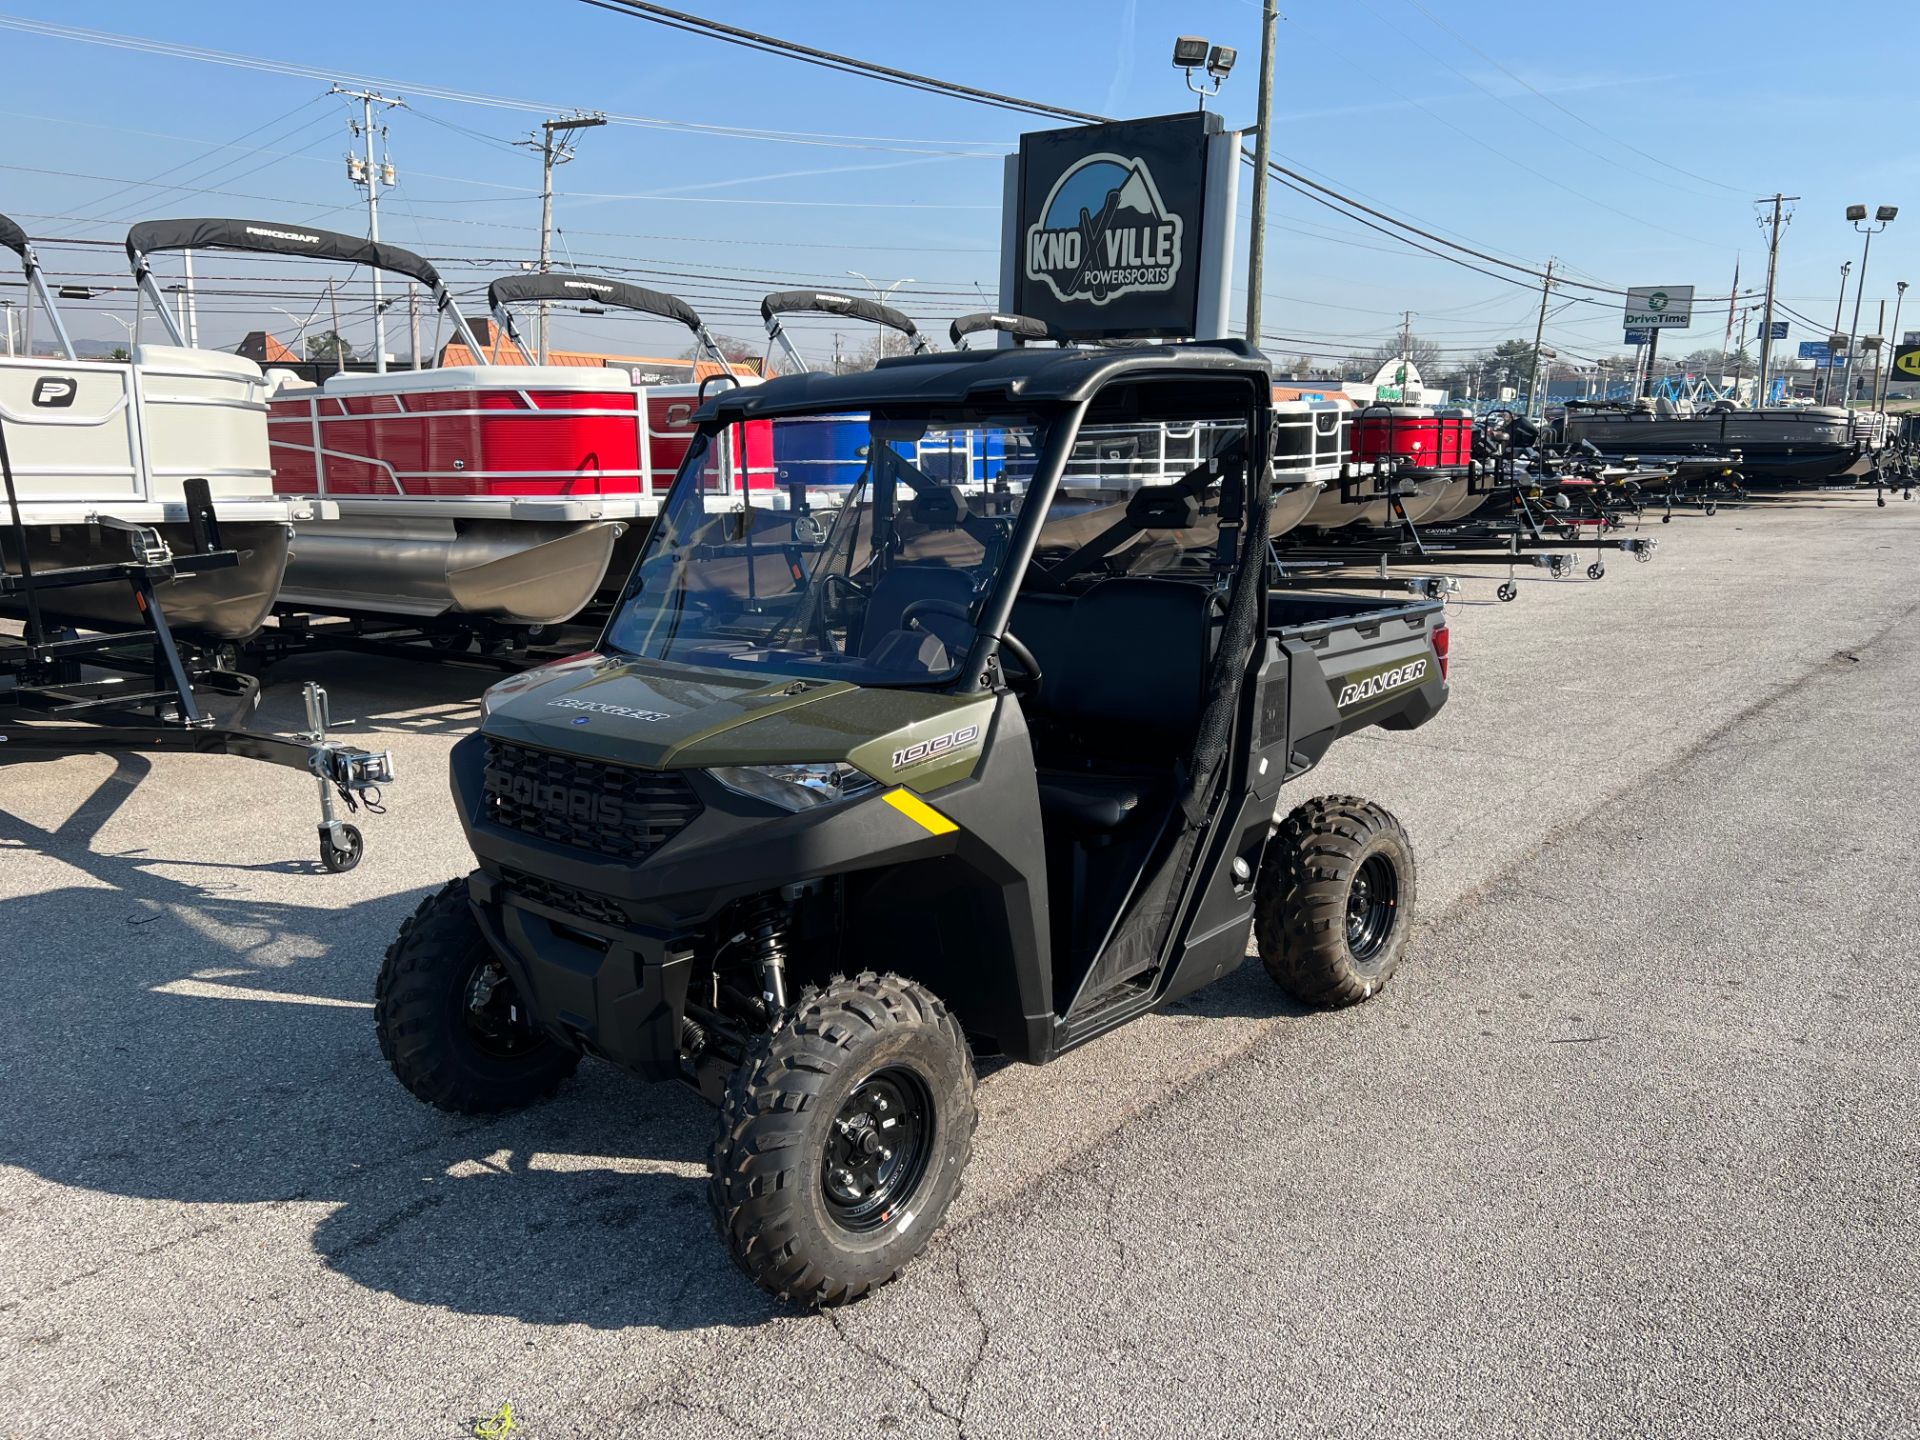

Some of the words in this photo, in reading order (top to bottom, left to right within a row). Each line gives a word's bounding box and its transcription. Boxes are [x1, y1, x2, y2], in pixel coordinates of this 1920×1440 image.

[1032, 215, 1174, 273] KNOXVILLE
[1084, 266, 1169, 285] POWERSPORTS
[1625, 313, 1688, 325] DriveTime
[1904, 356, 1920, 369] L
[1337, 659, 1427, 708] RANGER
[892, 724, 980, 769] 1000
[490, 769, 623, 826] POLARIS
